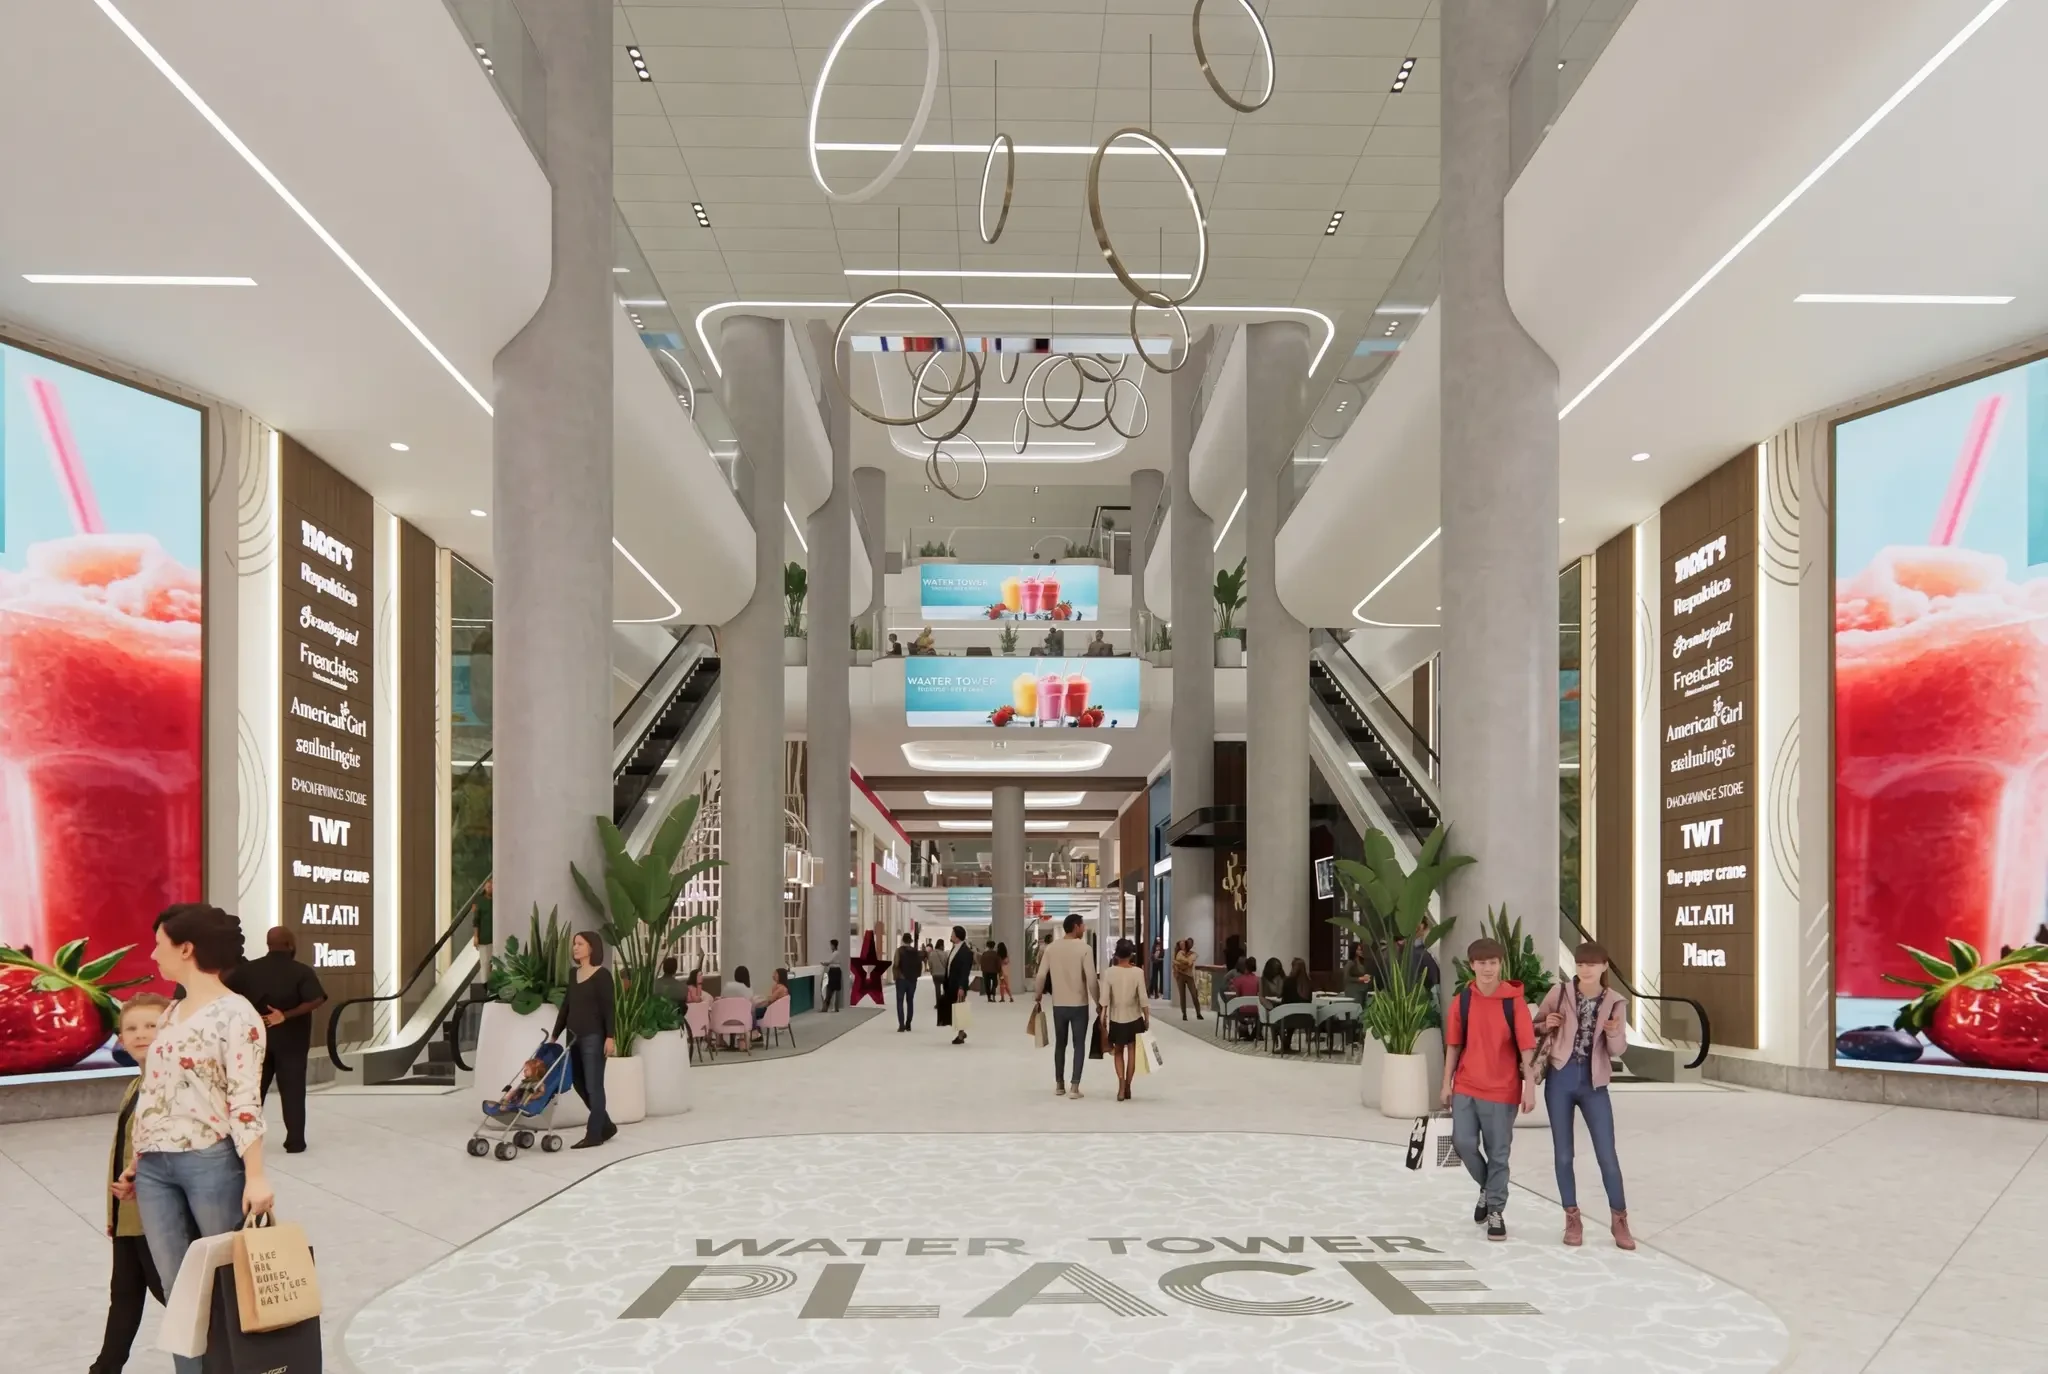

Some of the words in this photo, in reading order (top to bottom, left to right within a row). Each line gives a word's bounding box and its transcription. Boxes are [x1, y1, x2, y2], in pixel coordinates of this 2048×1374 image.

[290, 696, 346, 730] American
[347, 715, 367, 738] Girl
[1666, 716, 1718, 742] American
[1718, 781, 1744, 799] STORE
[308, 815, 351, 847] TWT
[1680, 818, 1723, 849] TWT
[293, 860, 312, 878] the
[1667, 868, 1683, 885] the
[302, 902, 360, 926] ALT.ATH
[1675, 904, 1734, 926] ALT.ATH
[695, 1237, 1031, 1257] WATER
[1088, 1236, 1446, 1254] TOWER
[617, 1260, 1544, 1319] PLACE
